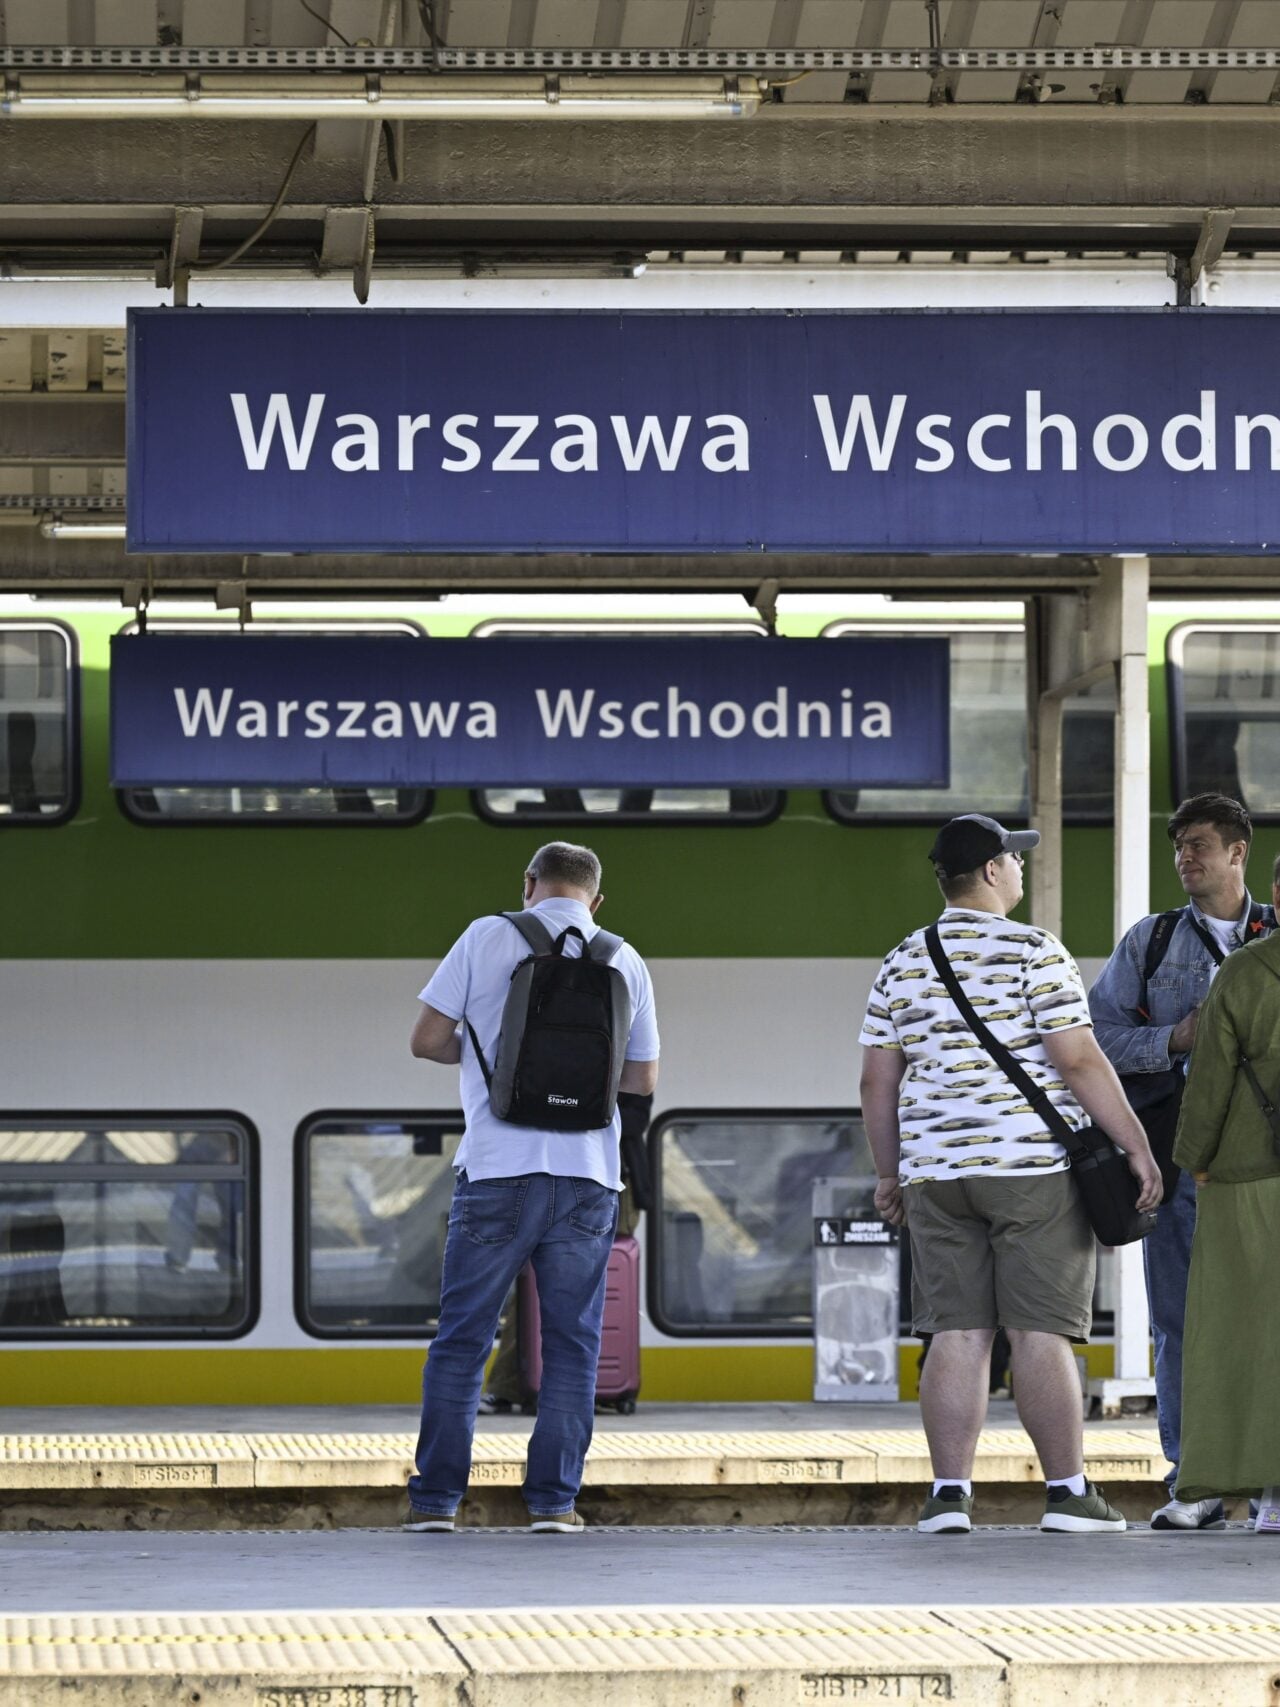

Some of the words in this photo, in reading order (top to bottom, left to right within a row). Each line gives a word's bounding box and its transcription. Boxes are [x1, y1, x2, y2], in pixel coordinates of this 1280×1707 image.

[231, 393, 750, 472] Warszawa
[174, 688, 497, 738] Warszawa
[535, 687, 892, 739] Wschodnia
